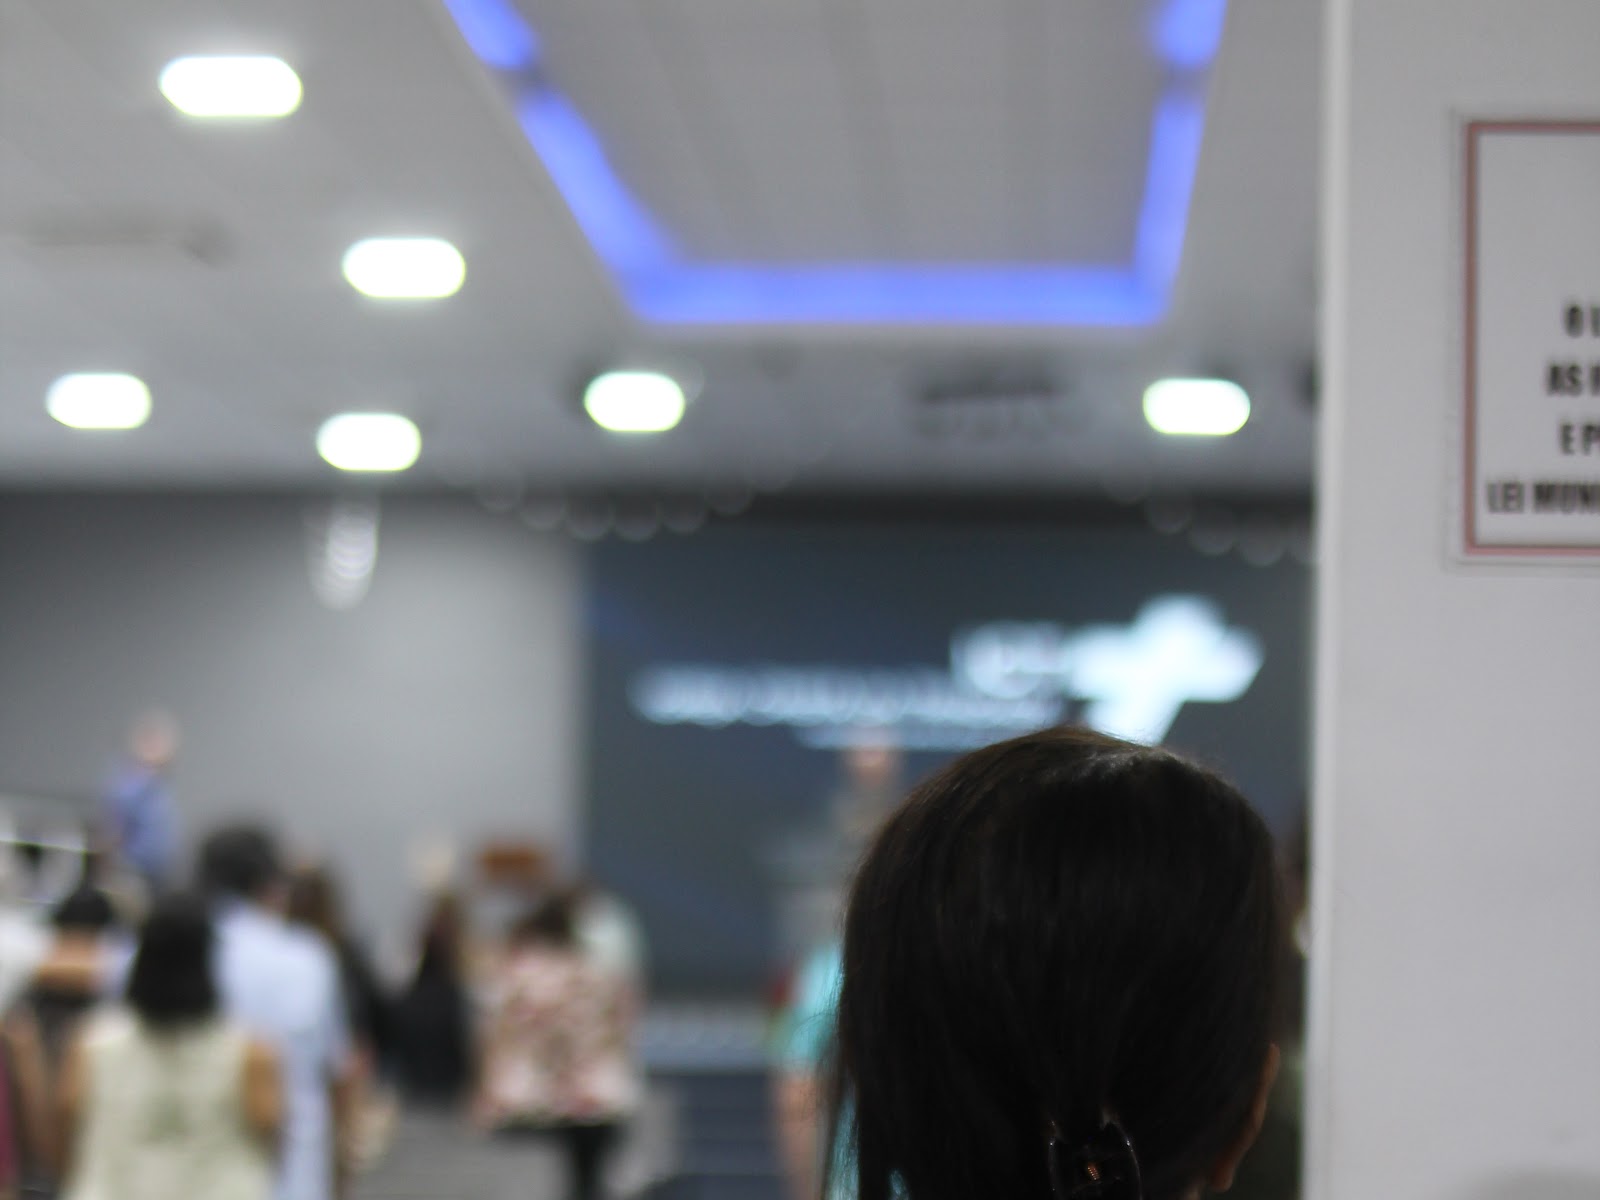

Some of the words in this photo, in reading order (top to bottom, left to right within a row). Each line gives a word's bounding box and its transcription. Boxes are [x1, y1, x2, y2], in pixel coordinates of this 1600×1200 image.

[1547, 362, 1583, 397] AS
[1560, 421, 1575, 456] E
[1486, 482, 1525, 514] LEI
